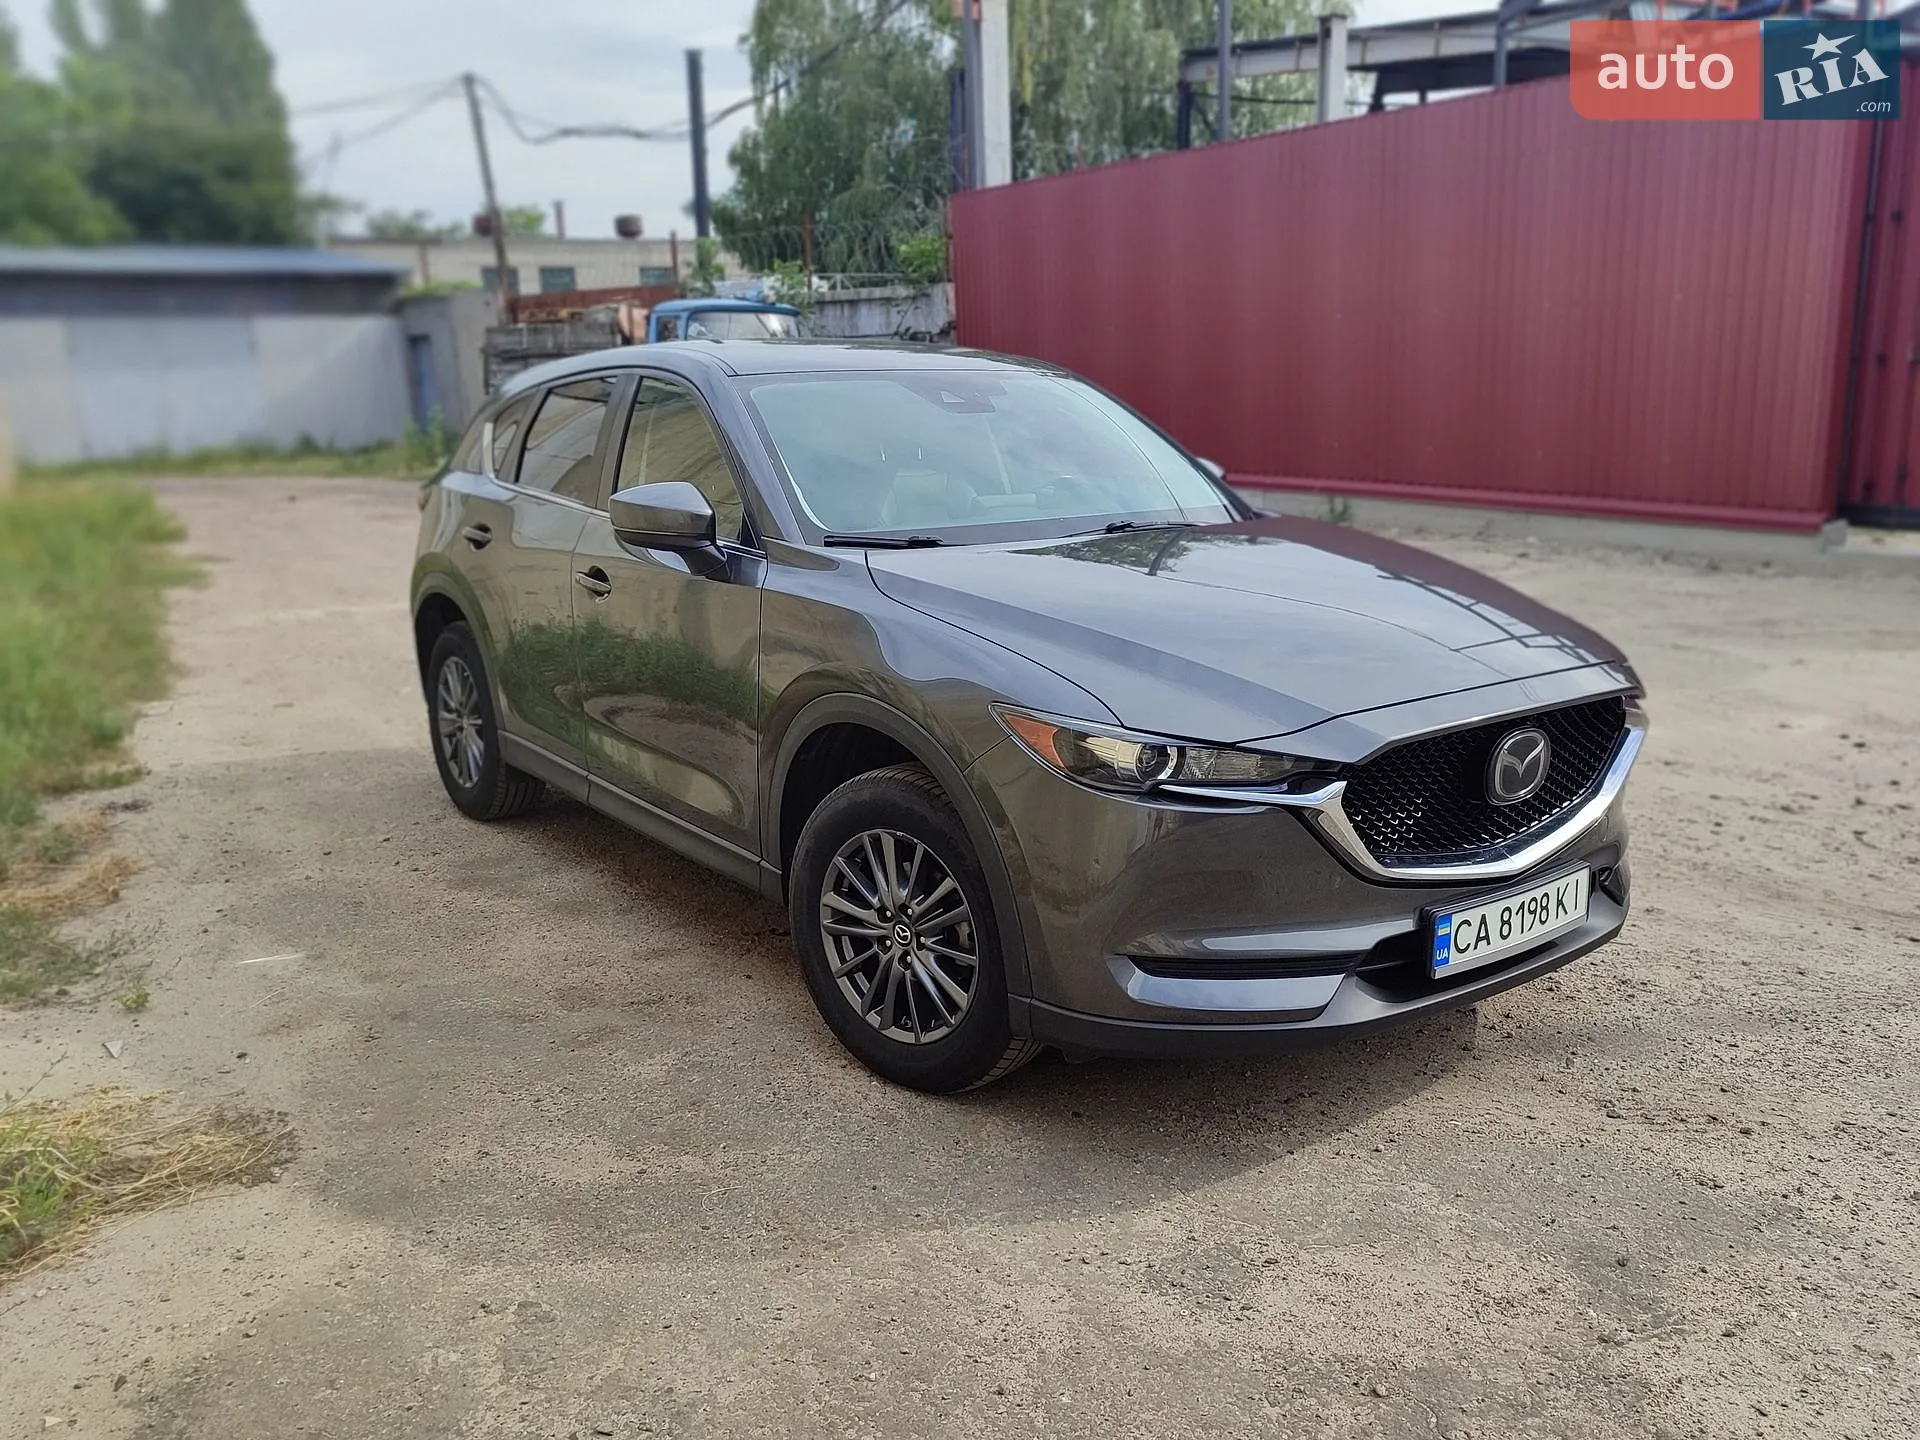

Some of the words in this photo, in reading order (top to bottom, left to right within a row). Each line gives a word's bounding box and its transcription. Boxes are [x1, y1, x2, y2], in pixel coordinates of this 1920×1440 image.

[1453, 913, 1491, 954] CA
[1499, 892, 1550, 940] 8198
[1555, 879, 1580, 919] KI
[1436, 948, 1449, 960] UA
